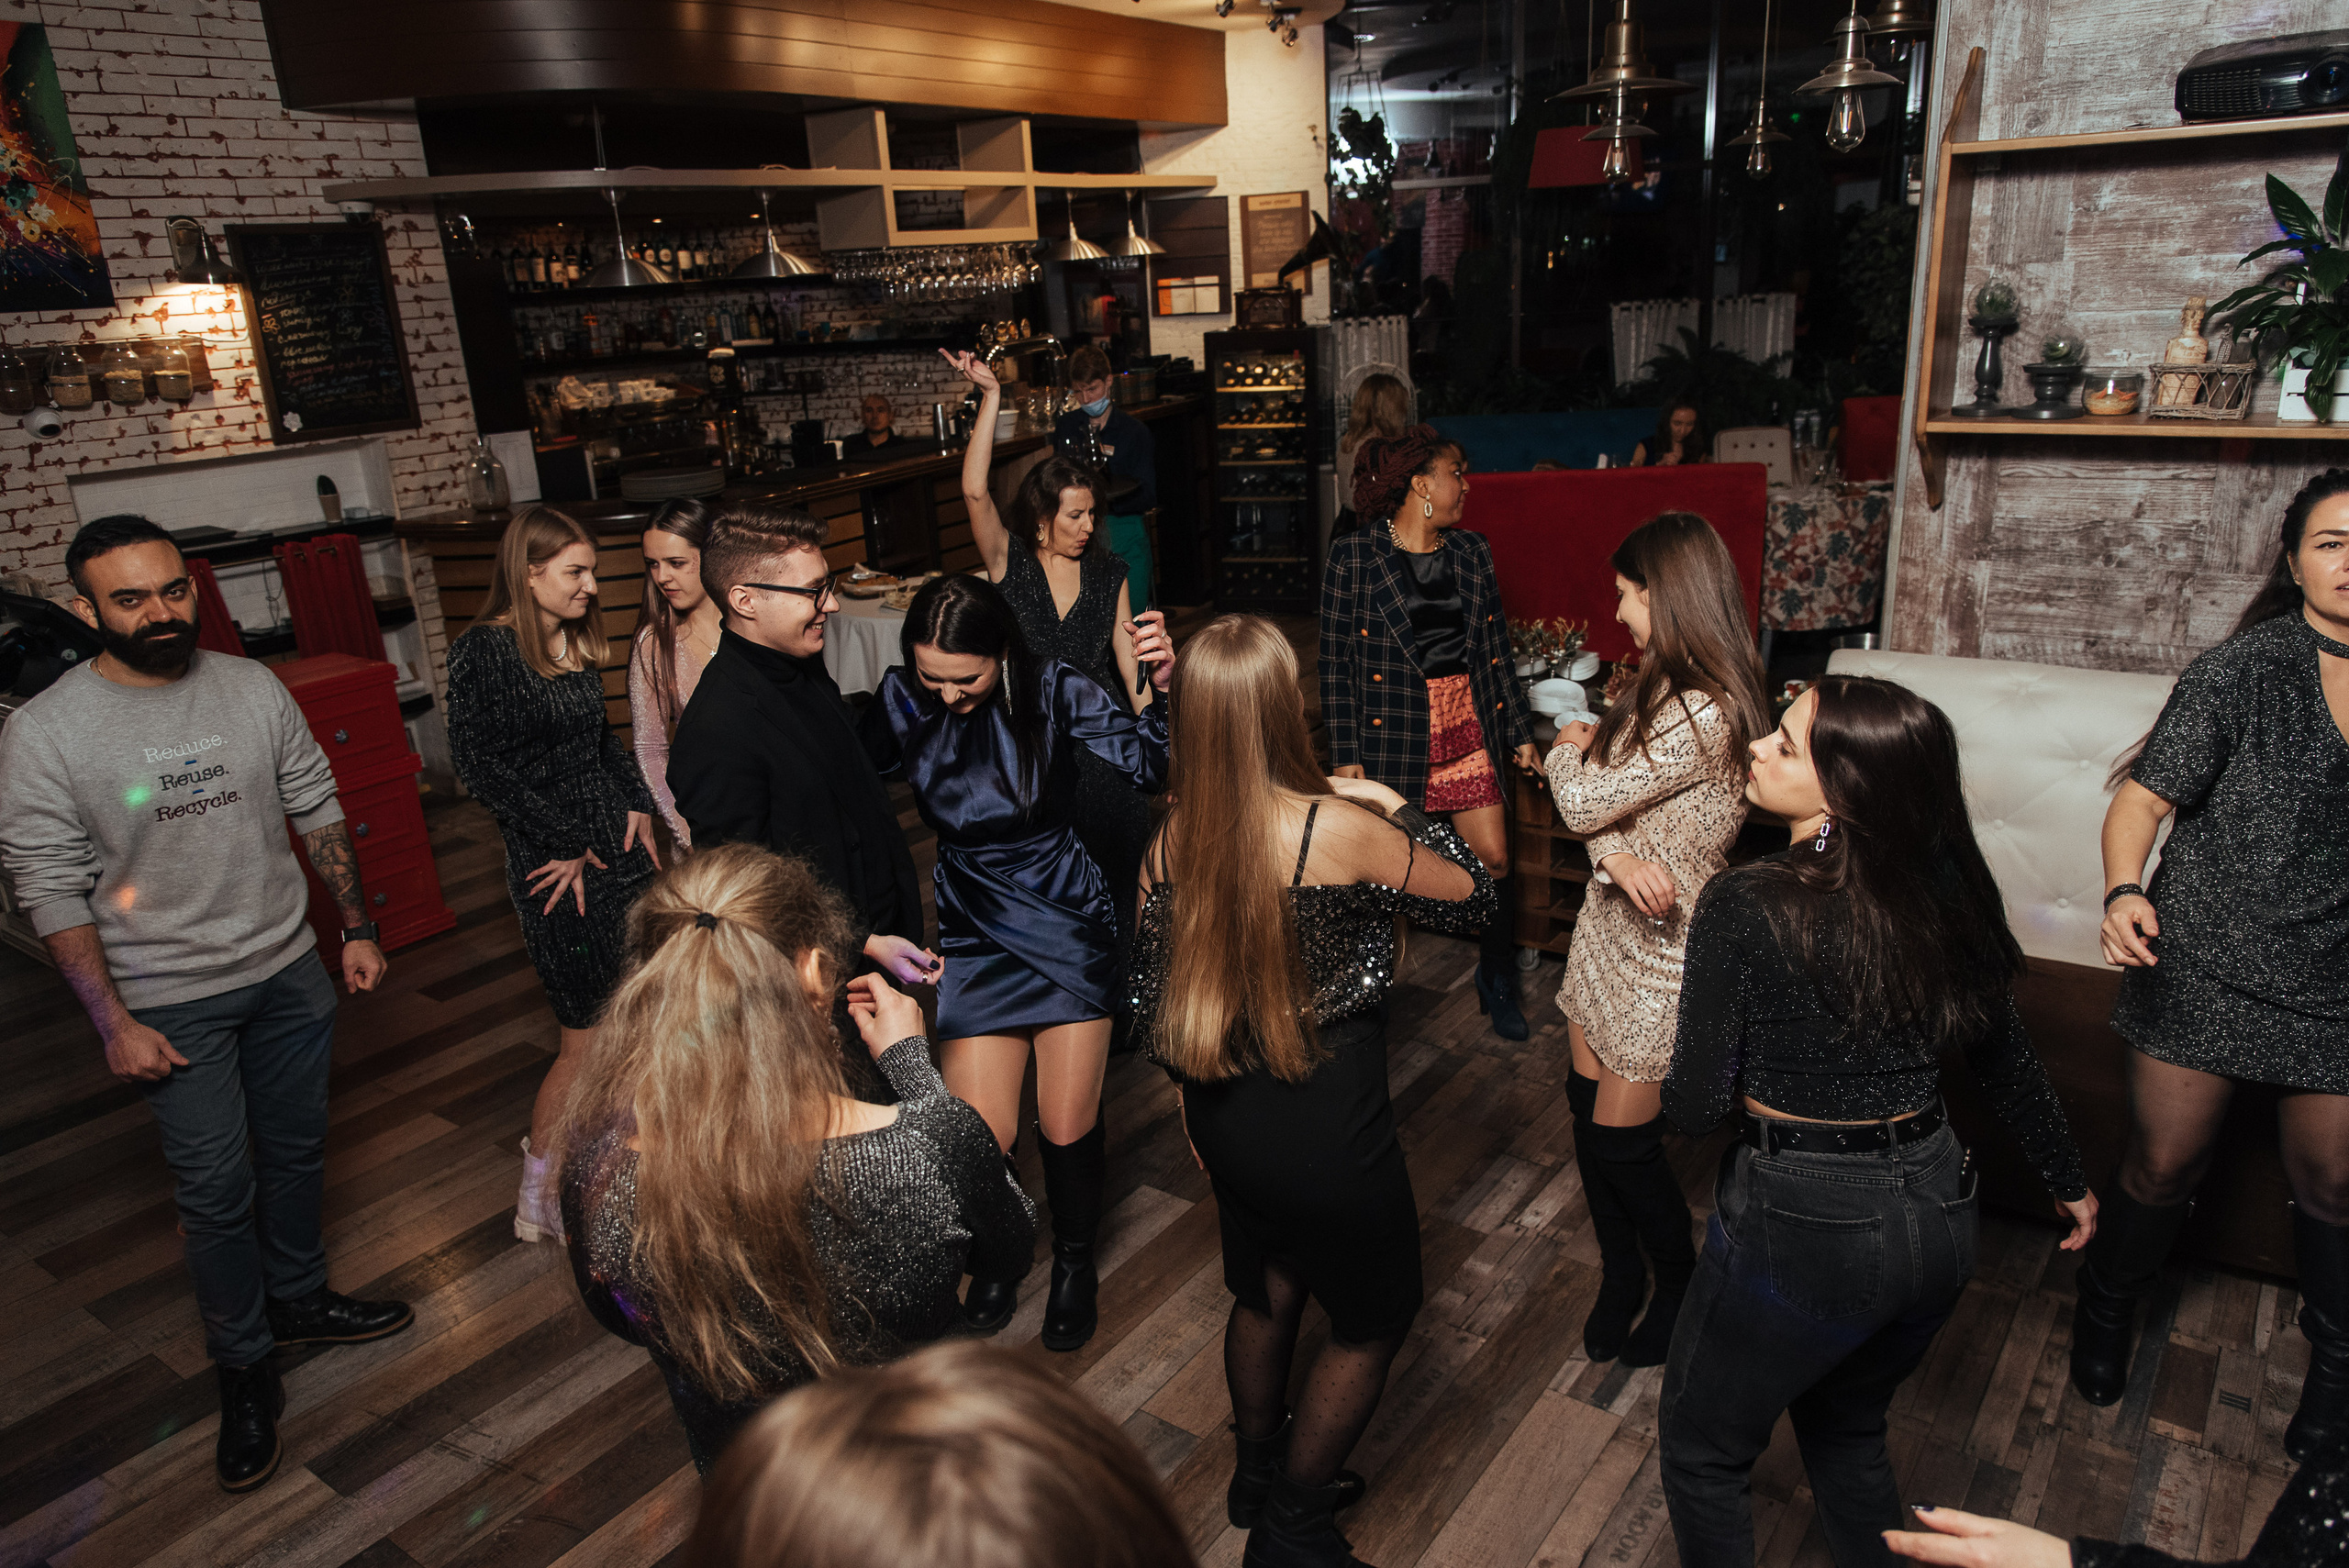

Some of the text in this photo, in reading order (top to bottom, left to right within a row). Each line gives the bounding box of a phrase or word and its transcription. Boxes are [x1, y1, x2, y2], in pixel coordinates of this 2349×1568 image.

[142, 734, 228, 764] Reduce.
[159, 764, 230, 792] Reuse.
[154, 790, 242, 822] Recycle.
[1609, 1483, 1664, 1563] ARADOR
